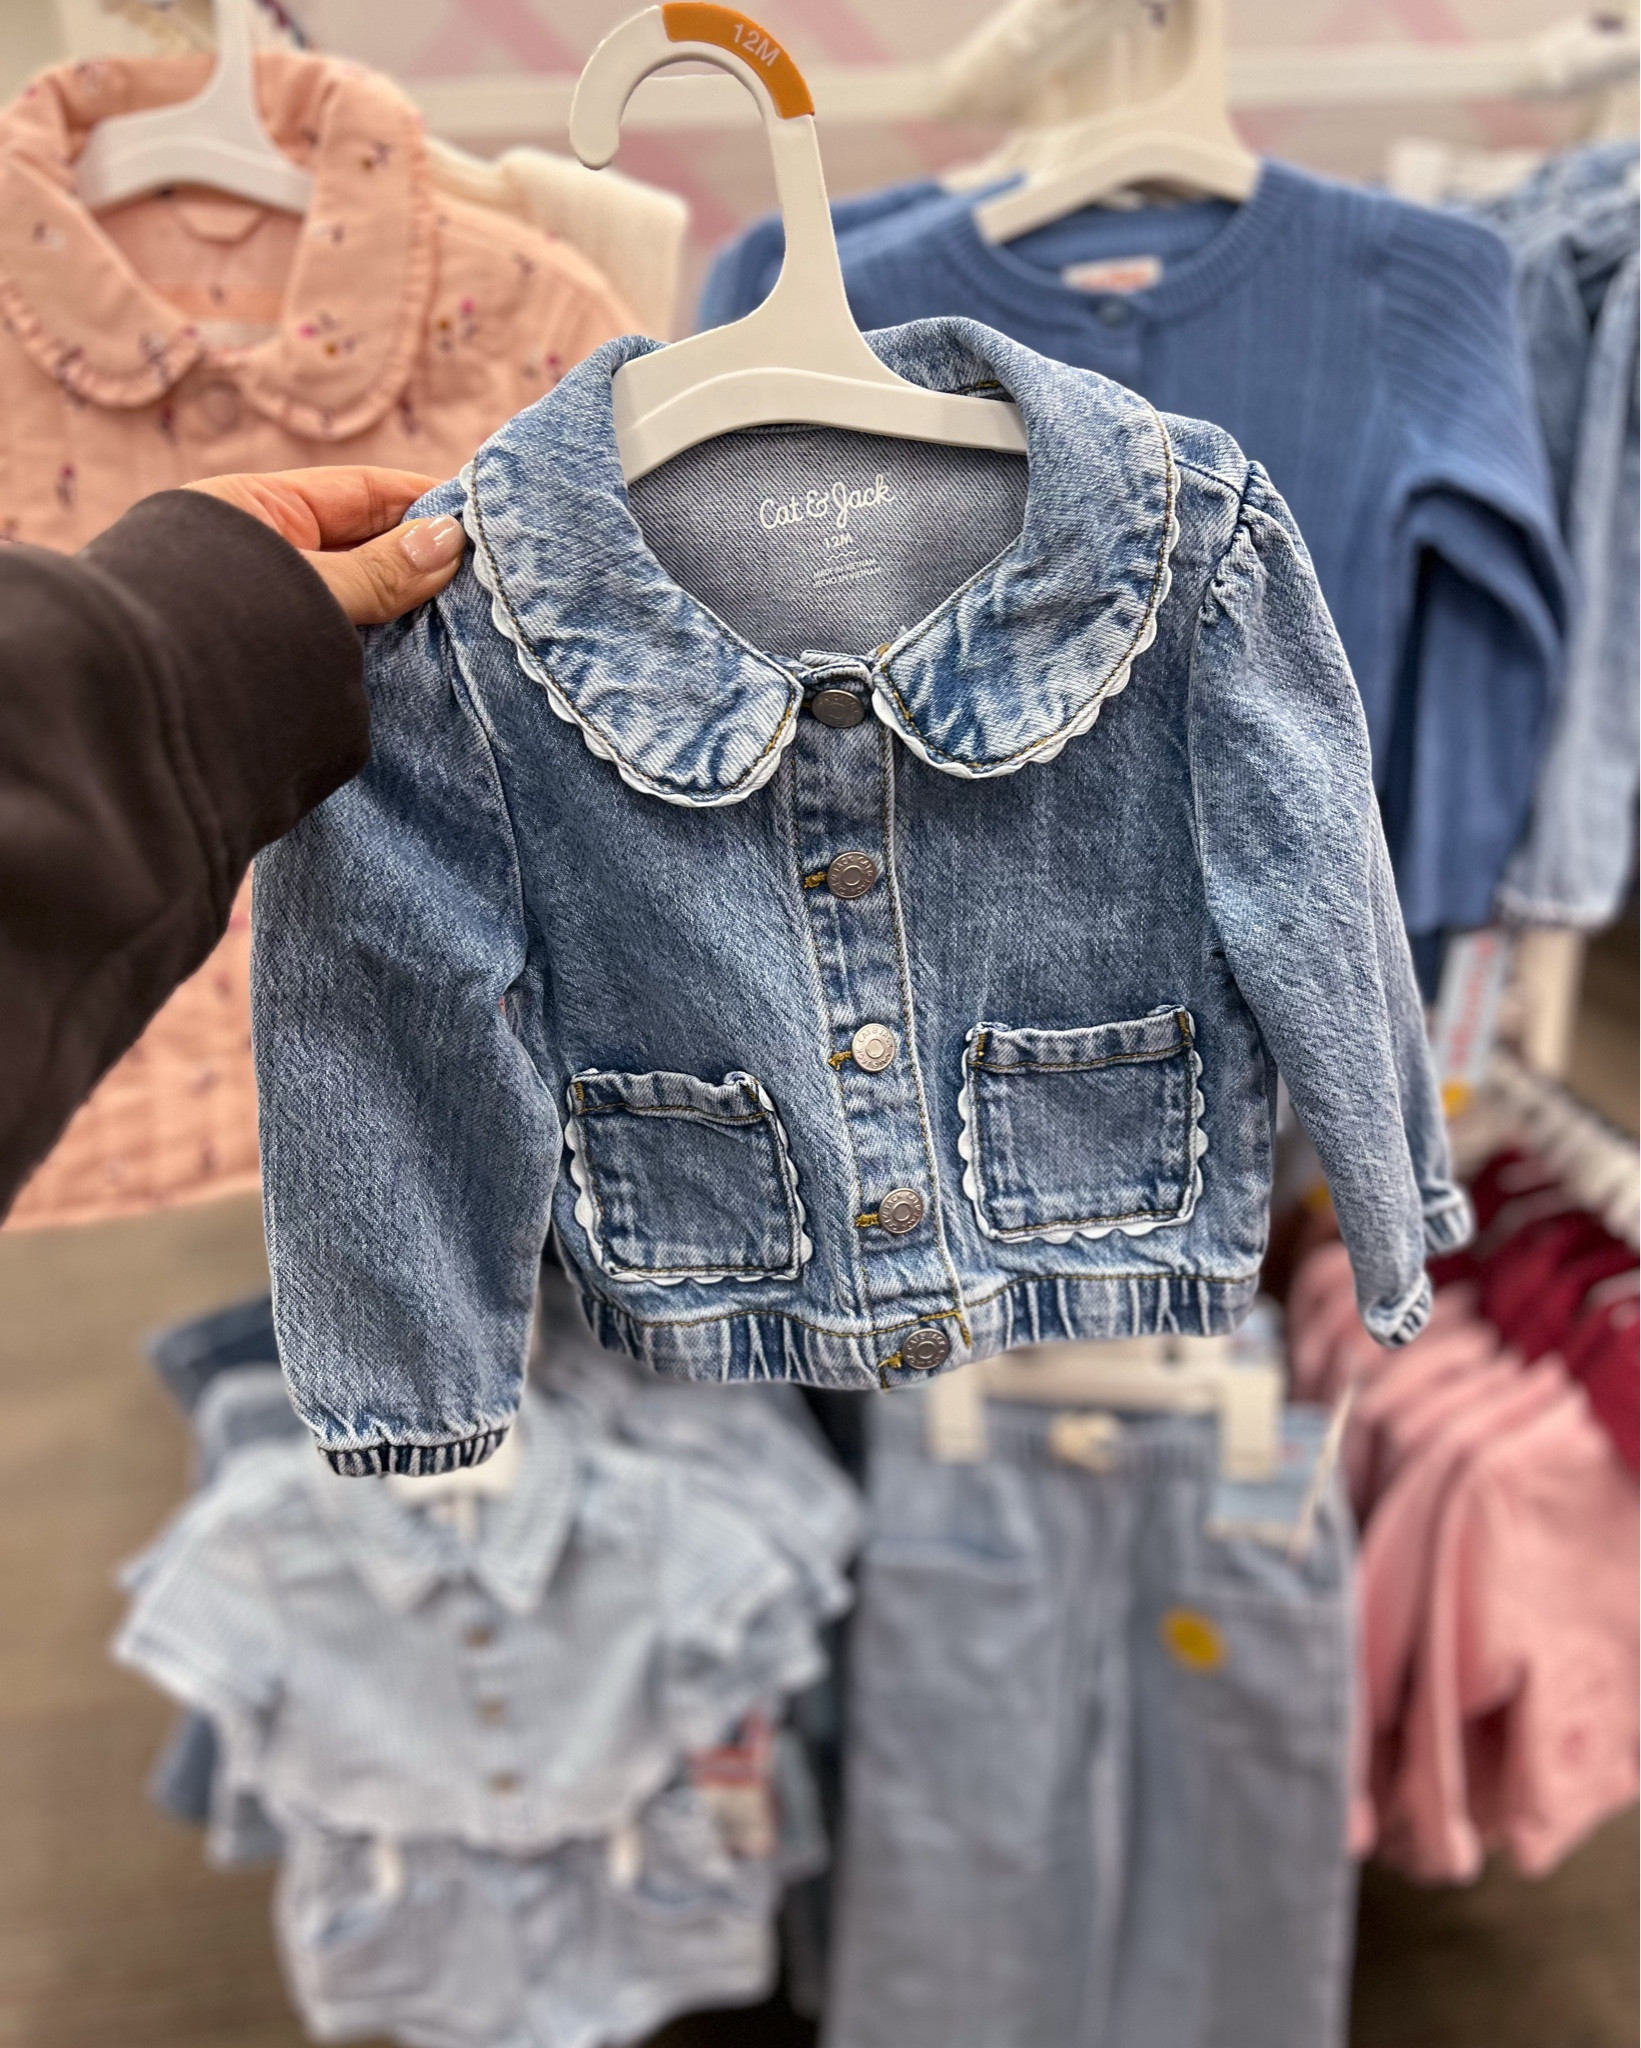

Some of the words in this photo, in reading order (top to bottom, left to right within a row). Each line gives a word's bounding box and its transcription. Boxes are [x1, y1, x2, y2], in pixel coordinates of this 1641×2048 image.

[733, 23, 780, 67] 12M
[759, 496, 804, 529] Cat
[806, 489, 829, 518] &
[832, 473, 895, 528] Jack
[823, 532, 853, 549] 12M
